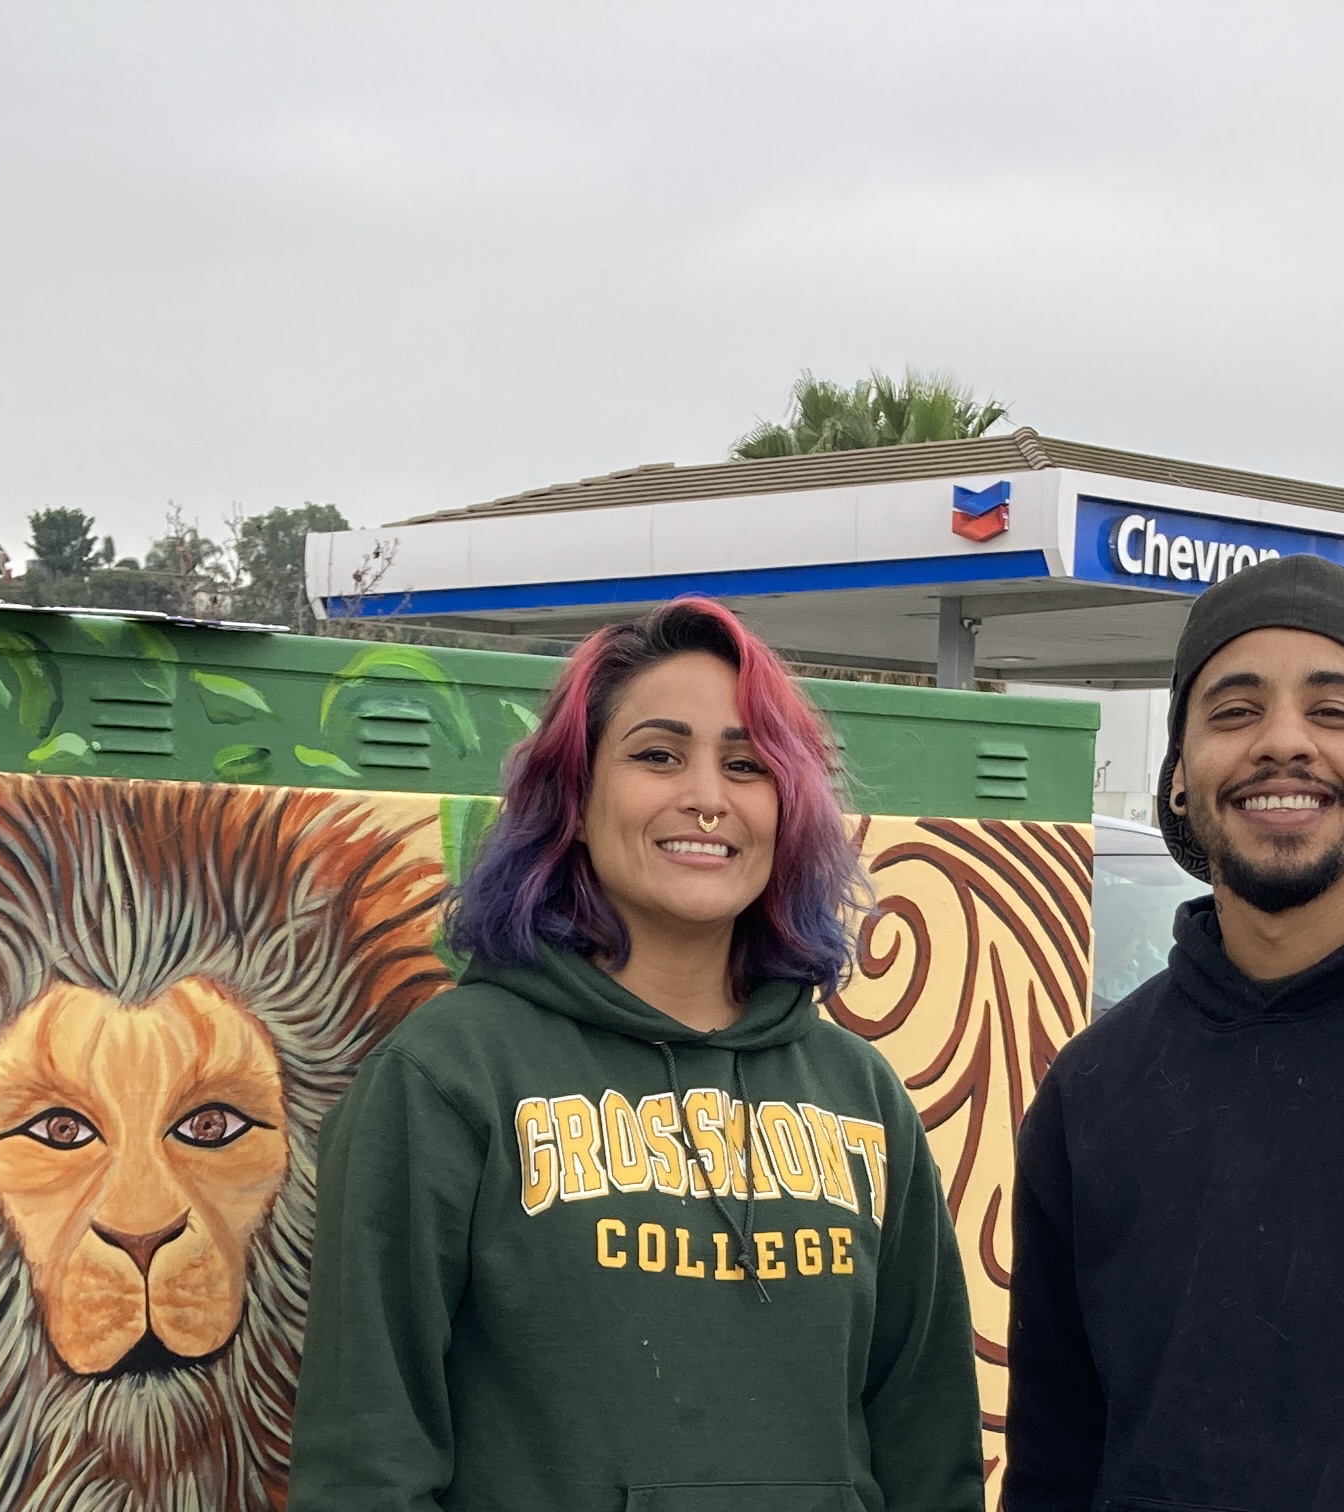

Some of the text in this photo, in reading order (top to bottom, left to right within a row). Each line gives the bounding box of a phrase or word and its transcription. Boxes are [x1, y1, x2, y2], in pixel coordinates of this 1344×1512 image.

[1130, 808, 1147, 821] Self
[514, 1088, 888, 1228] GROSSMONT
[595, 1218, 855, 1281] COLLEGE
